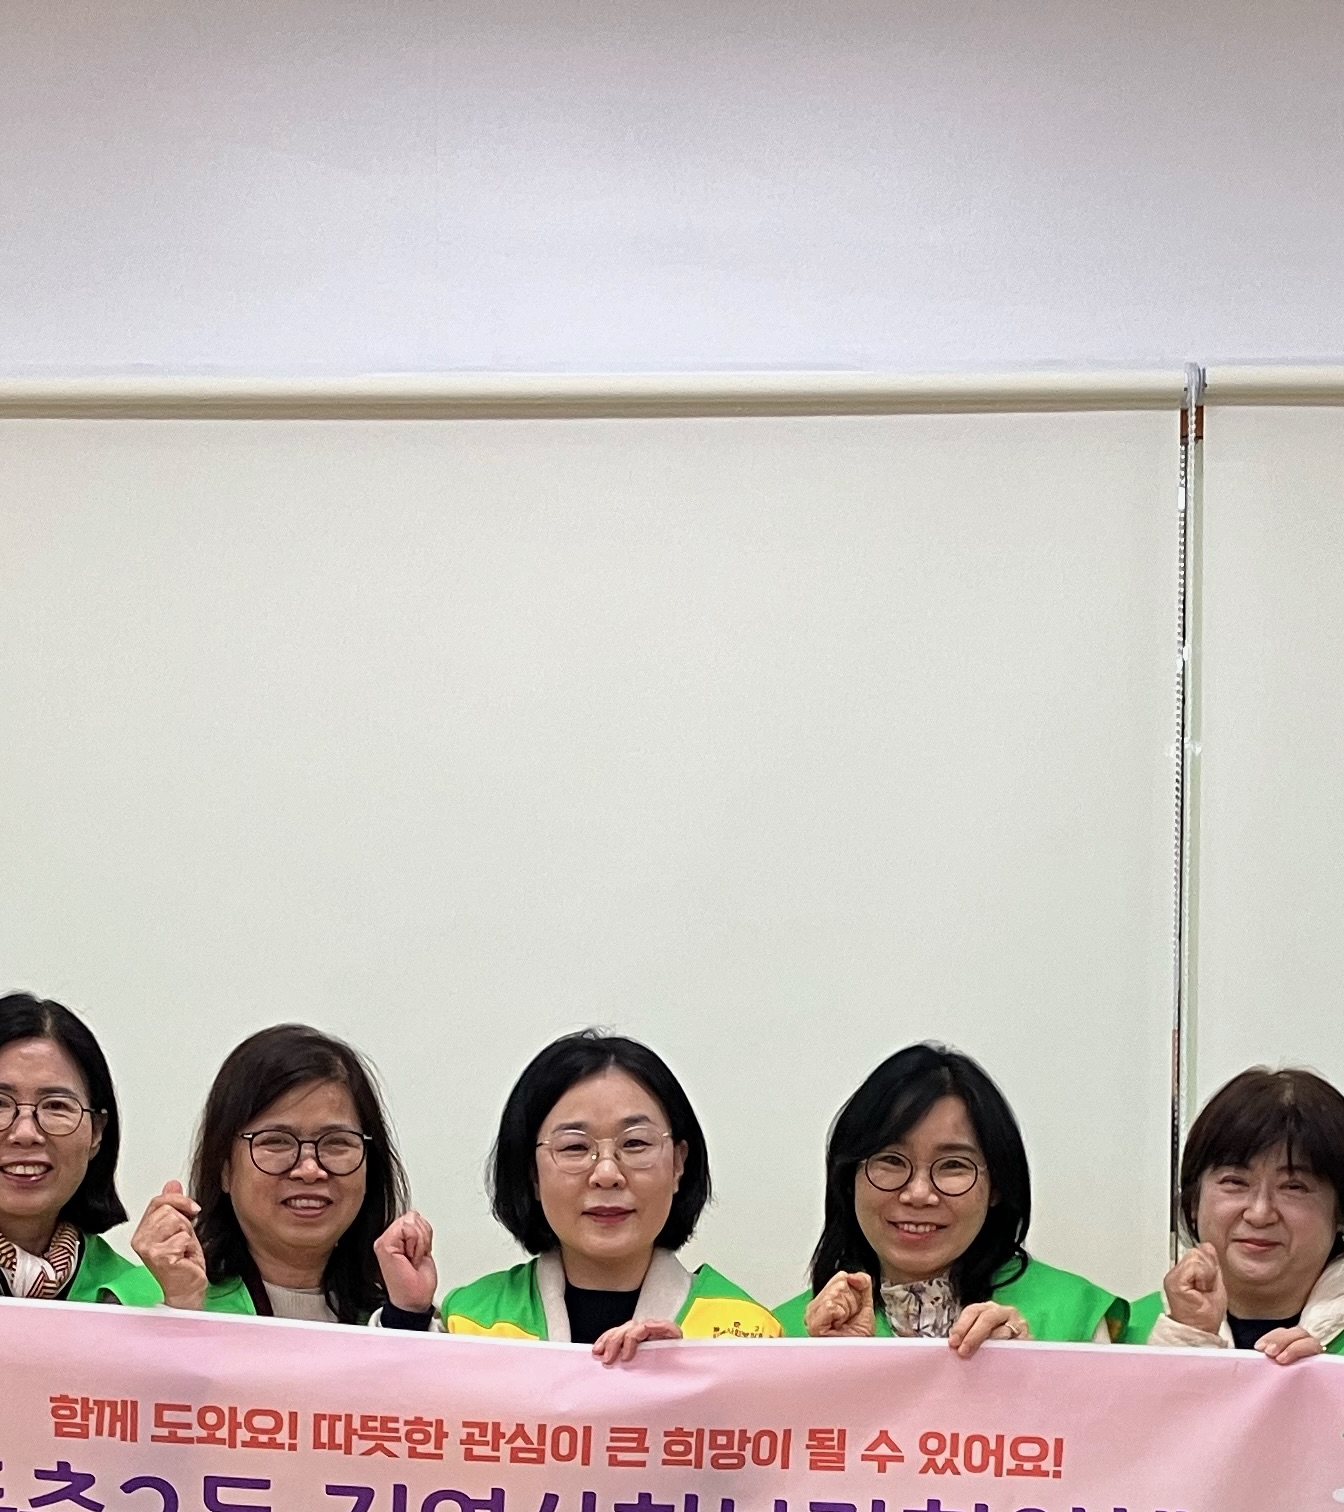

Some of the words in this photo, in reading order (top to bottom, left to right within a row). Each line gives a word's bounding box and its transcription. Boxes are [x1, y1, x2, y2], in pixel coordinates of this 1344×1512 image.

[49, 1393, 139, 1443] 함께
[150, 1401, 299, 1452] 도와요!
[313, 1413, 449, 1461] 따뜻한
[459, 1418, 593, 1467] 관심이
[606, 1425, 650, 1467] 큰
[662, 1426, 794, 1471] 희망이
[805, 1428, 848, 1472] 될
[859, 1430, 905, 1474] 수
[918, 1431, 1065, 1480] 있어요!
